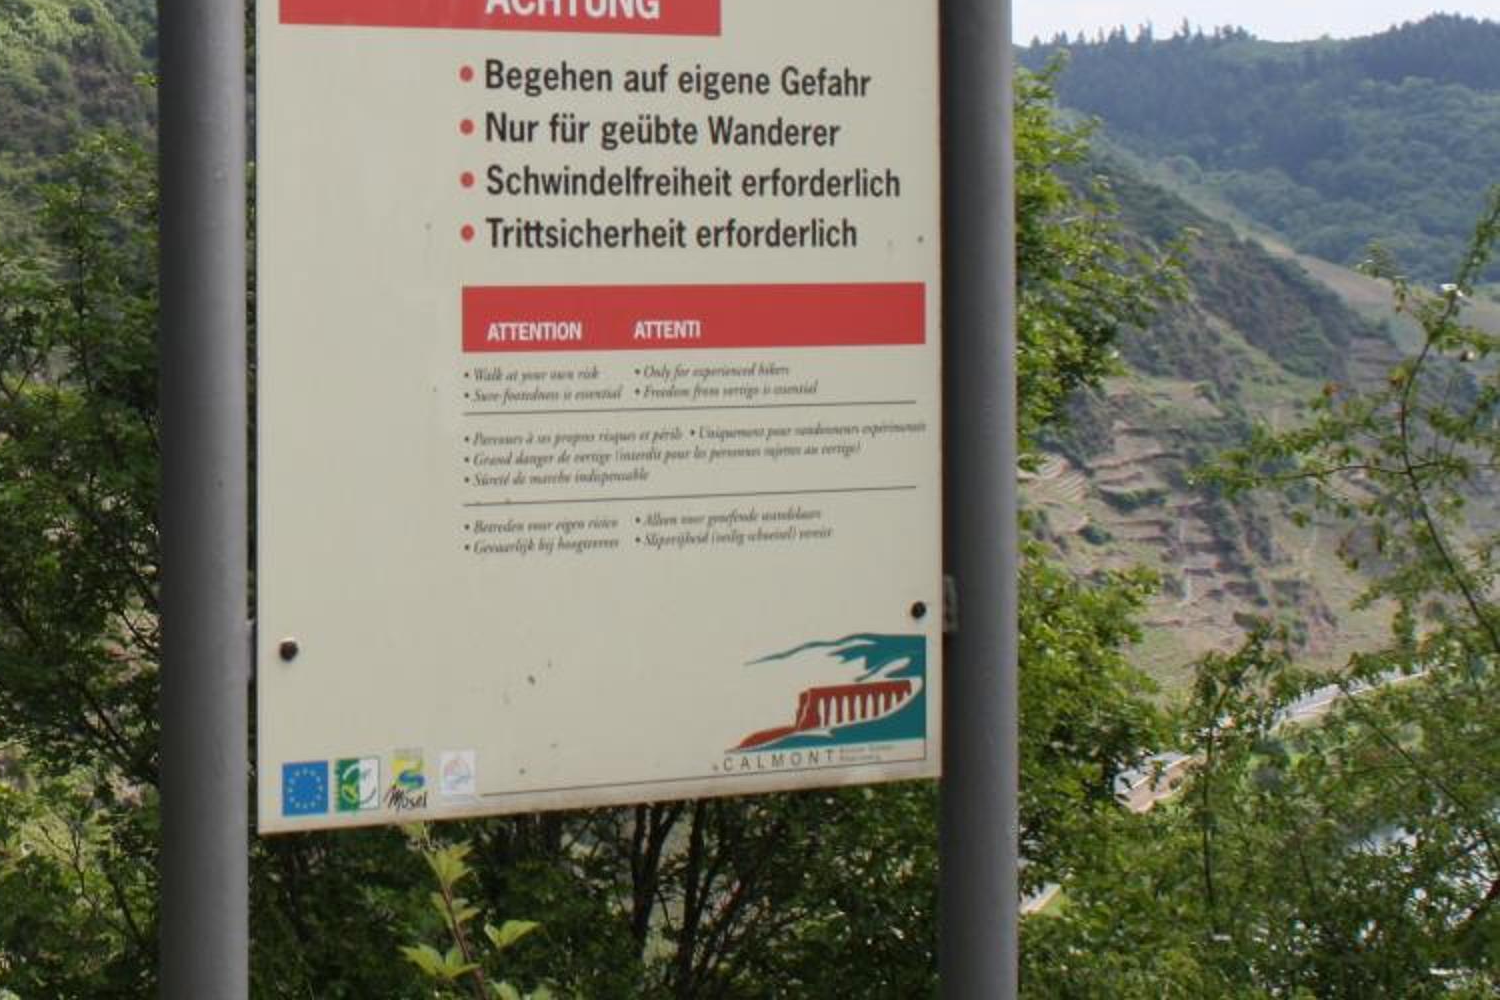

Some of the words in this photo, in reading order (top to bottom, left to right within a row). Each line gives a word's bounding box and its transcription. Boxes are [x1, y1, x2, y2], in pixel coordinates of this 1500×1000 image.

[485, 59, 613, 97] Begehen
[624, 64, 669, 95] auf
[678, 65, 771, 100] eigene
[781, 66, 871, 98] Gefahr
[485, 112, 539, 143] Nur
[549, 113, 591, 144] für
[601, 115, 698, 150] geübte
[708, 116, 841, 147] Wanderer
[486, 165, 732, 198] Schwindelfreiheit
[741, 167, 901, 199] erforderlich
[486, 217, 687, 248] Trittsicherheit
[695, 218, 858, 249] erforderlich
[487, 321, 583, 341] ATTENTION
[633, 319, 701, 339] ATTENTI
[473, 365, 502, 381] Walk
[505, 368, 518, 381] at
[519, 370, 548, 385] your
[550, 370, 575, 381] own
[643, 362, 671, 384] Only
[672, 361, 691, 384] for
[693, 361, 756, 382] experienced
[575, 383, 623, 400] essential
[642, 383, 689, 399] Freedom
[690, 381, 720, 401] from
[774, 377, 820, 394] essential
[598, 428, 638, 447] risques
[473, 450, 513, 467] Grand
[514, 449, 553, 469] danger
[556, 449, 571, 464] de
[662, 449, 691, 465] pour
[512, 468, 527, 485] de
[723, 748, 835, 774] CALMONT
